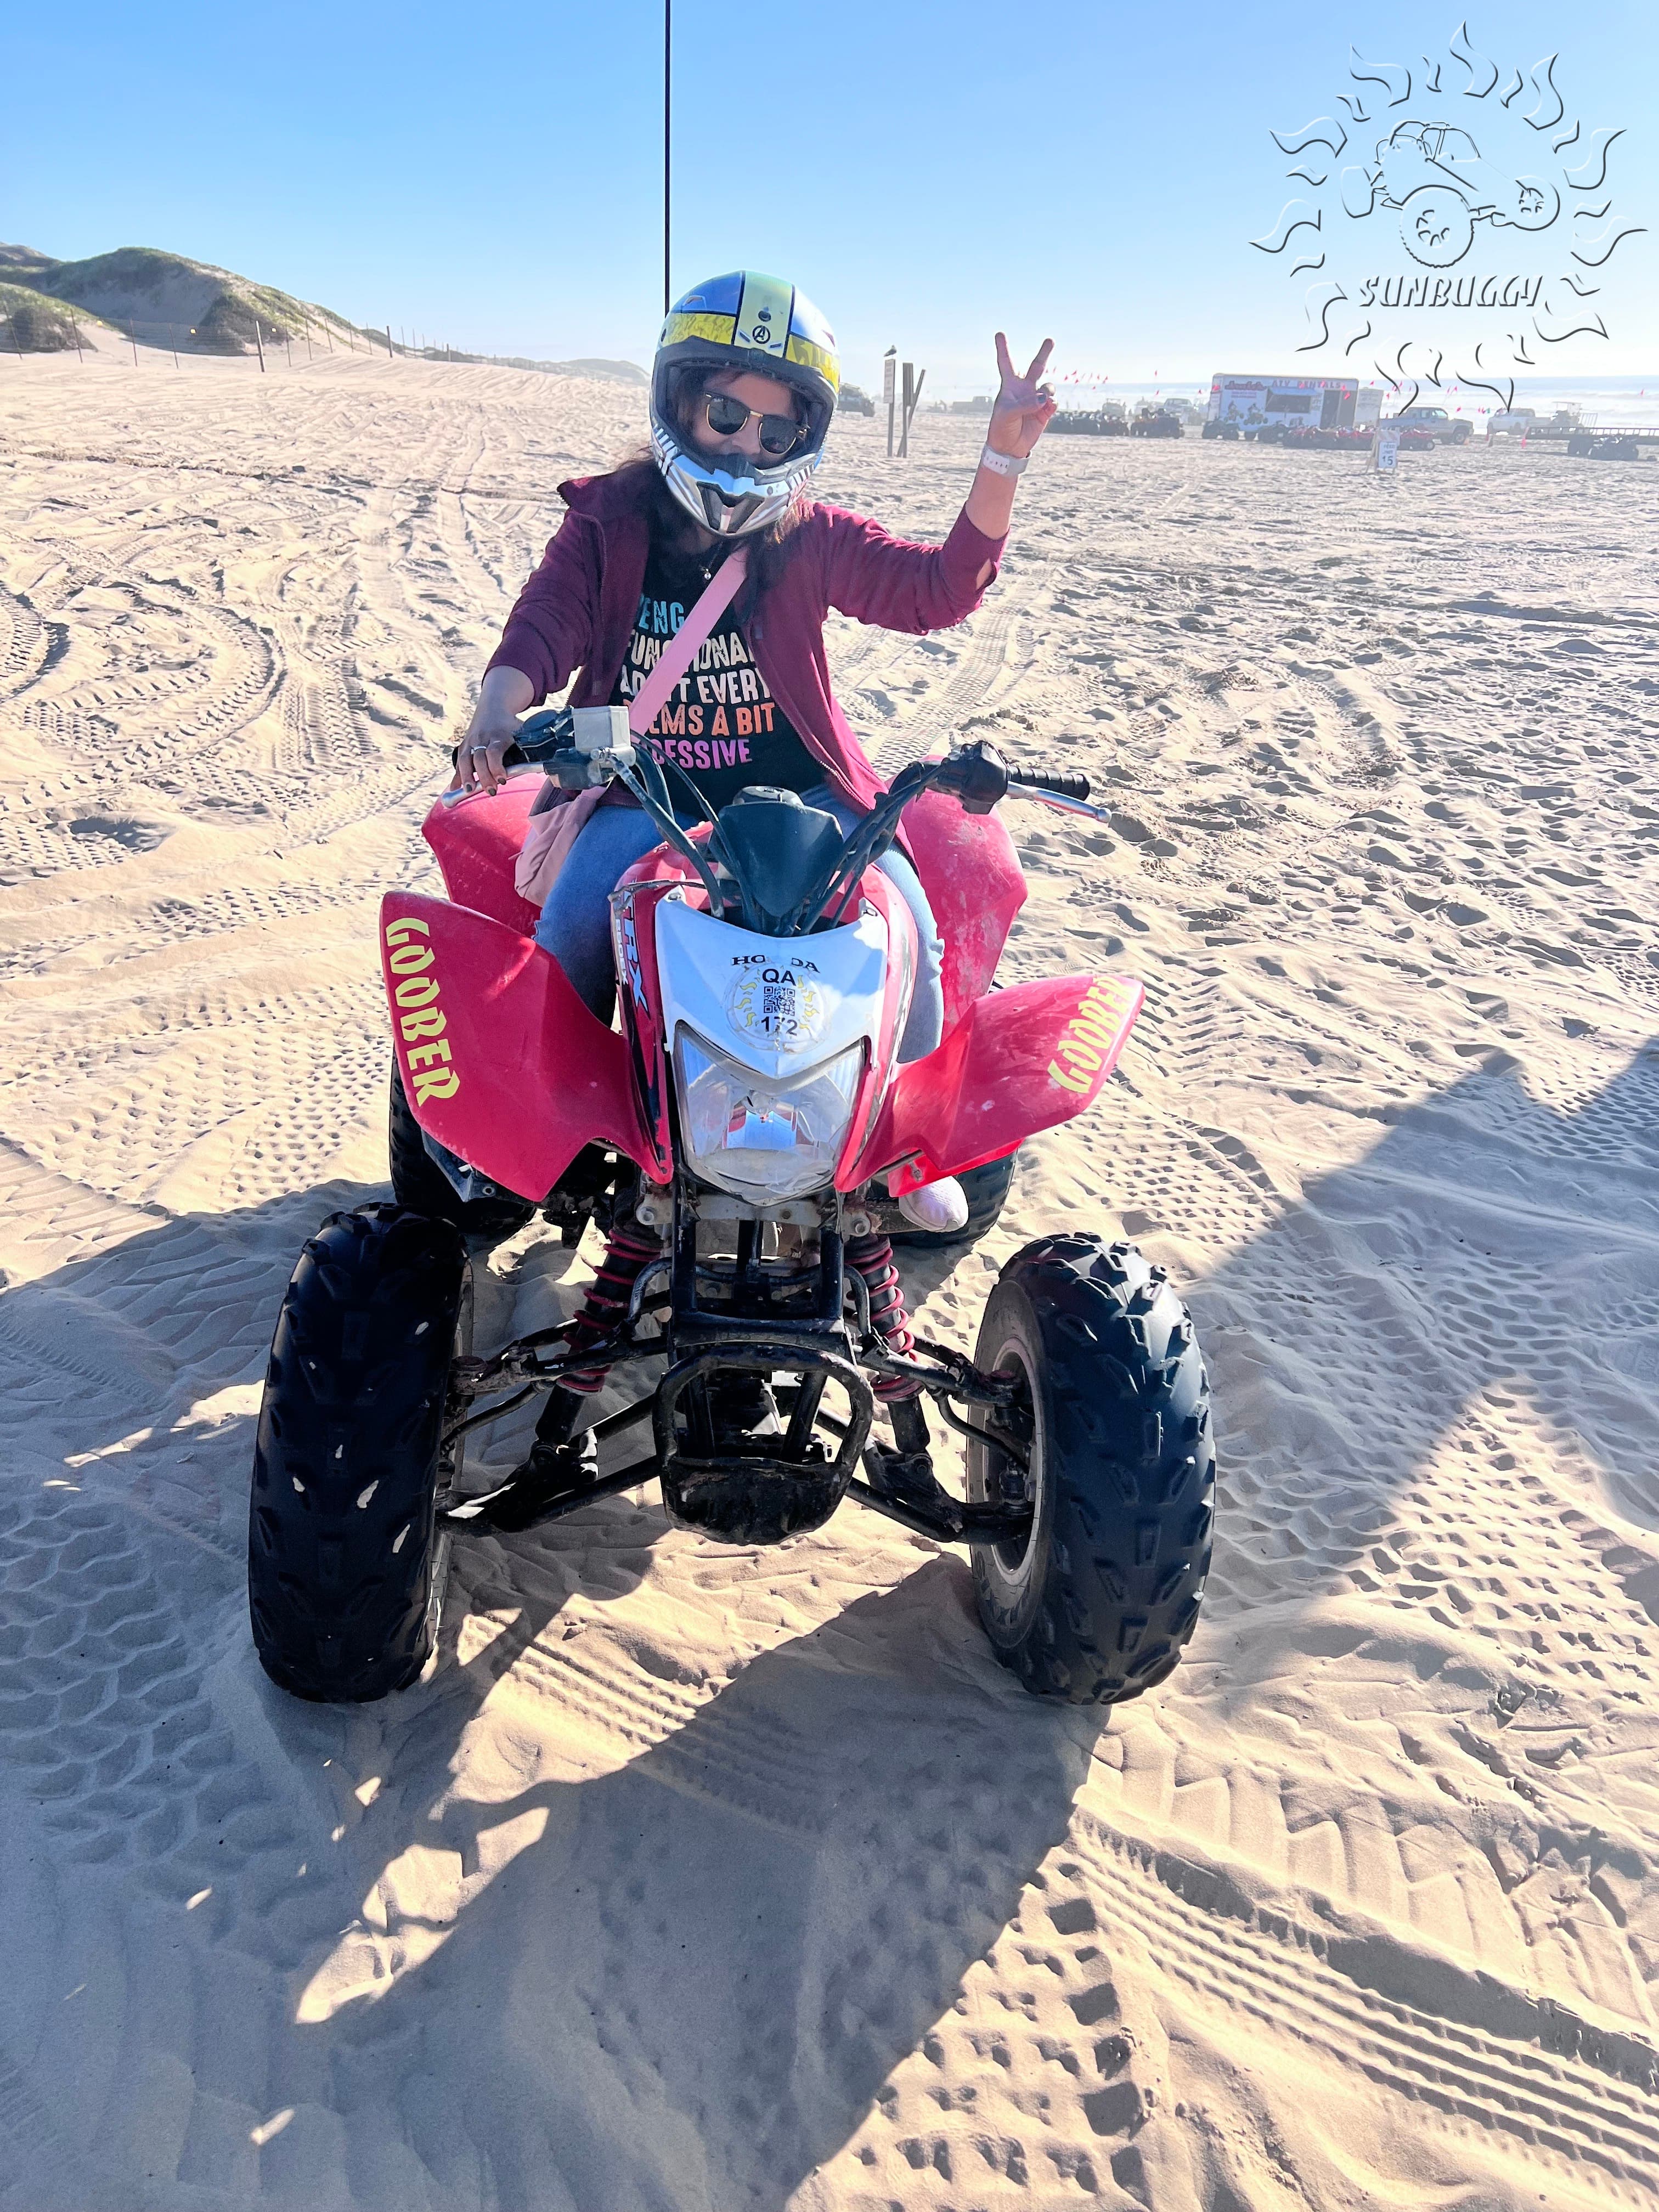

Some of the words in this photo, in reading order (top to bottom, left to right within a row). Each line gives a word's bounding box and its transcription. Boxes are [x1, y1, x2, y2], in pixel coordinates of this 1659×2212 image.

[1382, 455, 1393, 466] 15
[620, 664, 691, 703] ADT
[623, 699, 704, 736] EMS
[711, 706, 730, 736] A
[736, 702, 776, 735] BIT
[641, 738, 753, 769] CESSIVE
[731, 955, 821, 974] HODA
[762, 968, 797, 986] QA
[386, 917, 461, 1108] GOOBER
[760, 1016, 798, 1036] 172
